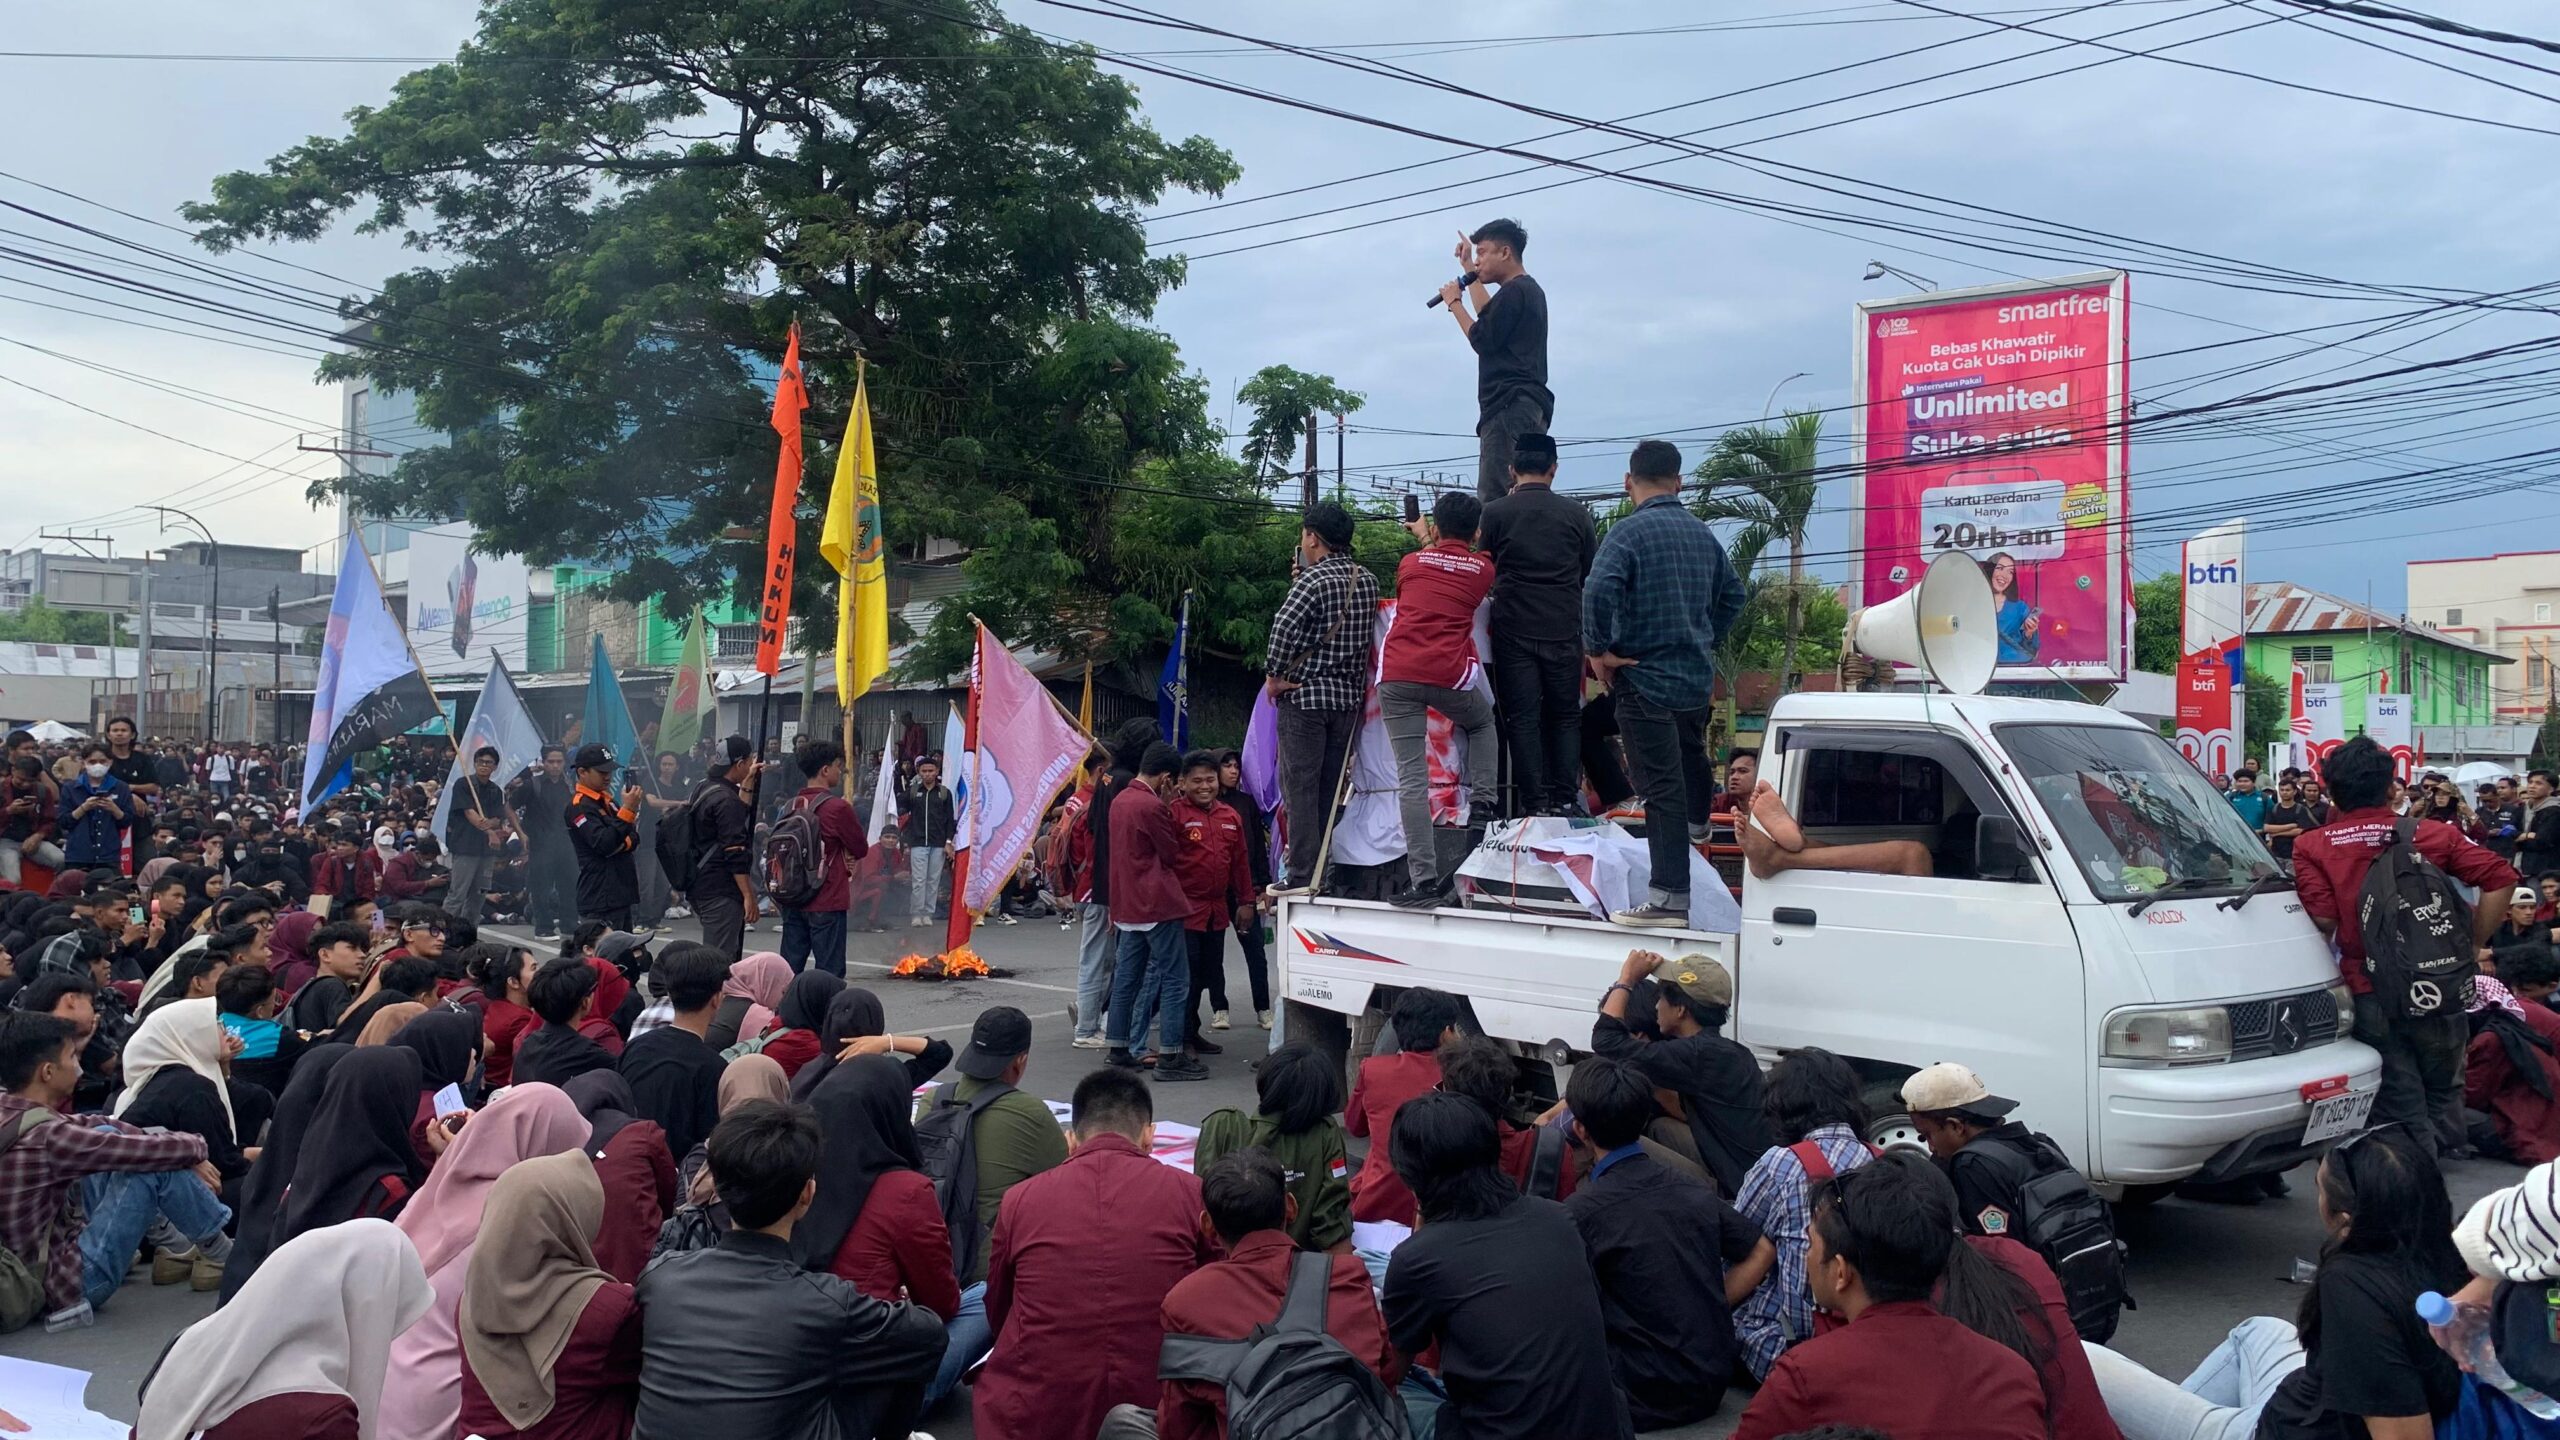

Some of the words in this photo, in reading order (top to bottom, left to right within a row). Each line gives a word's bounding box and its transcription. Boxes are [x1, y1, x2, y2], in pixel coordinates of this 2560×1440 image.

[1930, 342, 1977, 357] Bebas
[1981, 332, 2056, 350] Khawatir
[1903, 359, 1948, 375] Kuota
[1952, 357, 1983, 369] Gak
[1986, 350, 2026, 365] Usah
[2030, 345, 2086, 363] Dipikir
[1917, 381, 1958, 392] Internetan
[1960, 376, 1982, 386] Pakai
[1914, 383, 2068, 420] Unlimited
[1944, 494, 1981, 507] Kartu
[1984, 491, 2041, 505] Perdana
[2068, 495, 2091, 507] hanya
[1974, 506, 2009, 518] Hanya
[1933, 523, 2052, 549] 20rb-an
[2189, 559, 2237, 585] btn
[761, 544, 792, 645] HUKUM
[2193, 679, 2215, 691] btn
[2306, 697, 2327, 707] btn
[2379, 705, 2398, 716] btn
[2325, 826, 2360, 836] KABINET
[2363, 823, 2393, 831] MERAH
[1313, 947, 1339, 955] CARRY
